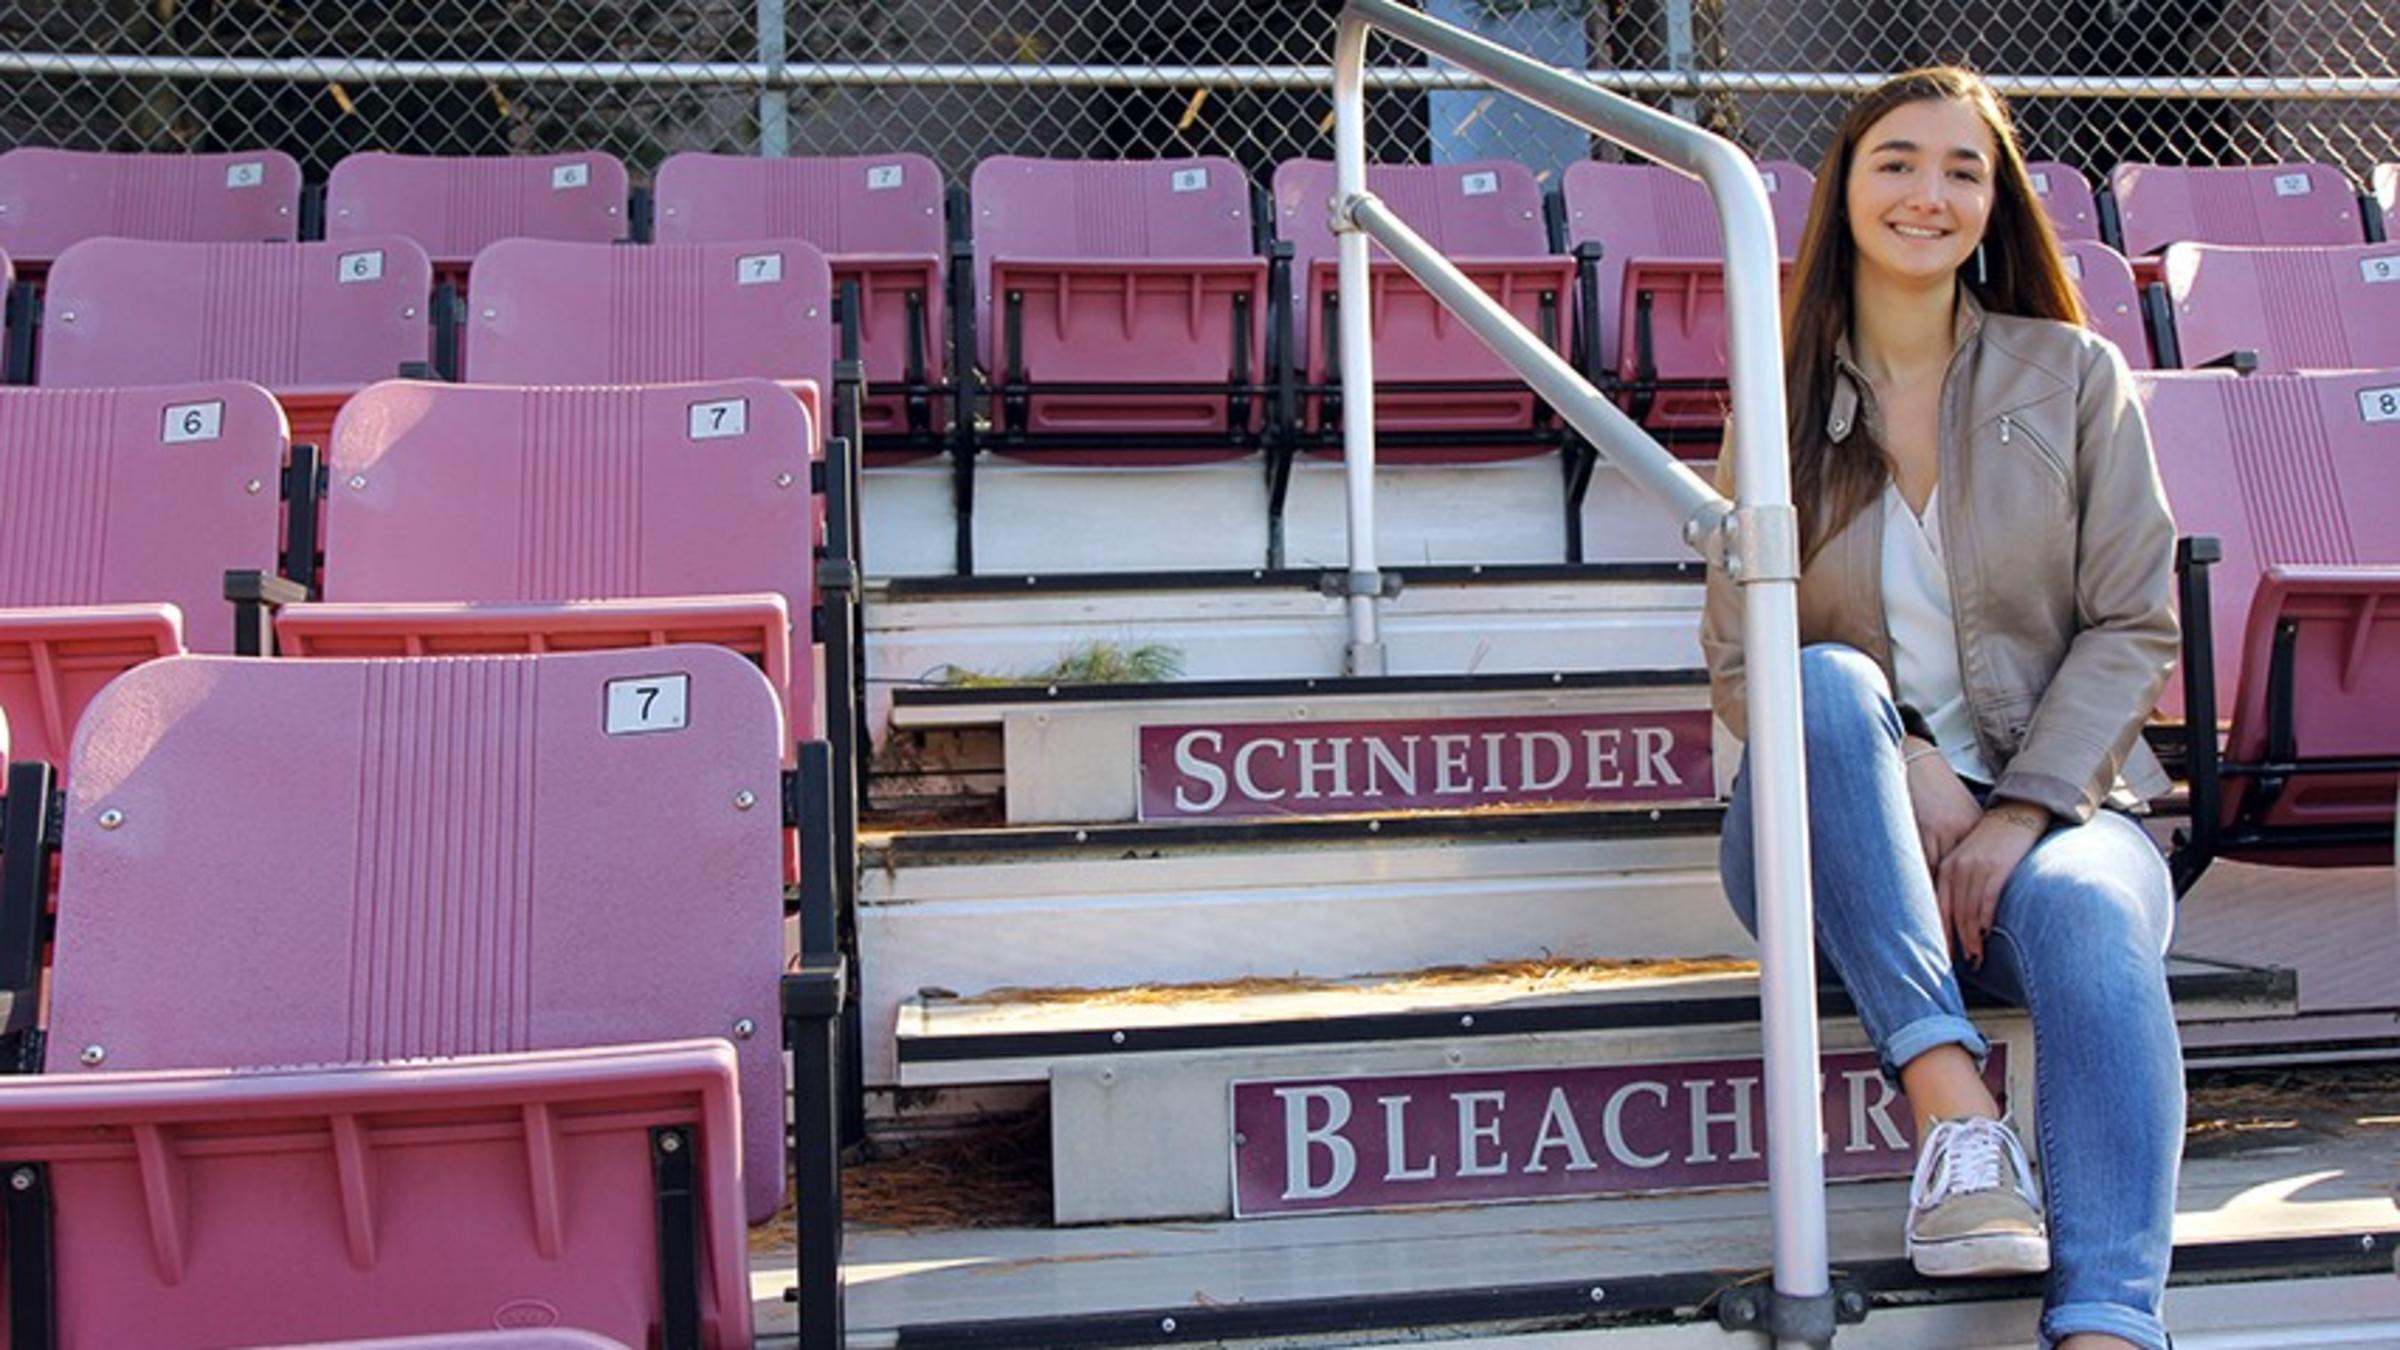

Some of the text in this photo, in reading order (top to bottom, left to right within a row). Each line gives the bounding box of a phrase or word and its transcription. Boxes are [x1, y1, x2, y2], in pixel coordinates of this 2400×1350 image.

[565, 170, 576, 182] 6
[881, 171, 891, 182] 7
[1184, 174, 1195, 186] 8
[1474, 177, 1485, 189] 9
[354, 258, 367, 275] 6
[754, 261, 767, 276] 7
[2375, 262, 2390, 276] 9
[2380, 394, 2397, 414] 8
[184, 411, 201, 434] 6
[711, 408, 726, 429] 7
[636, 687, 659, 720] 7
[1174, 726, 1682, 812] SCHNEIDER
[1274, 1068, 1910, 1201] BLEACHR
